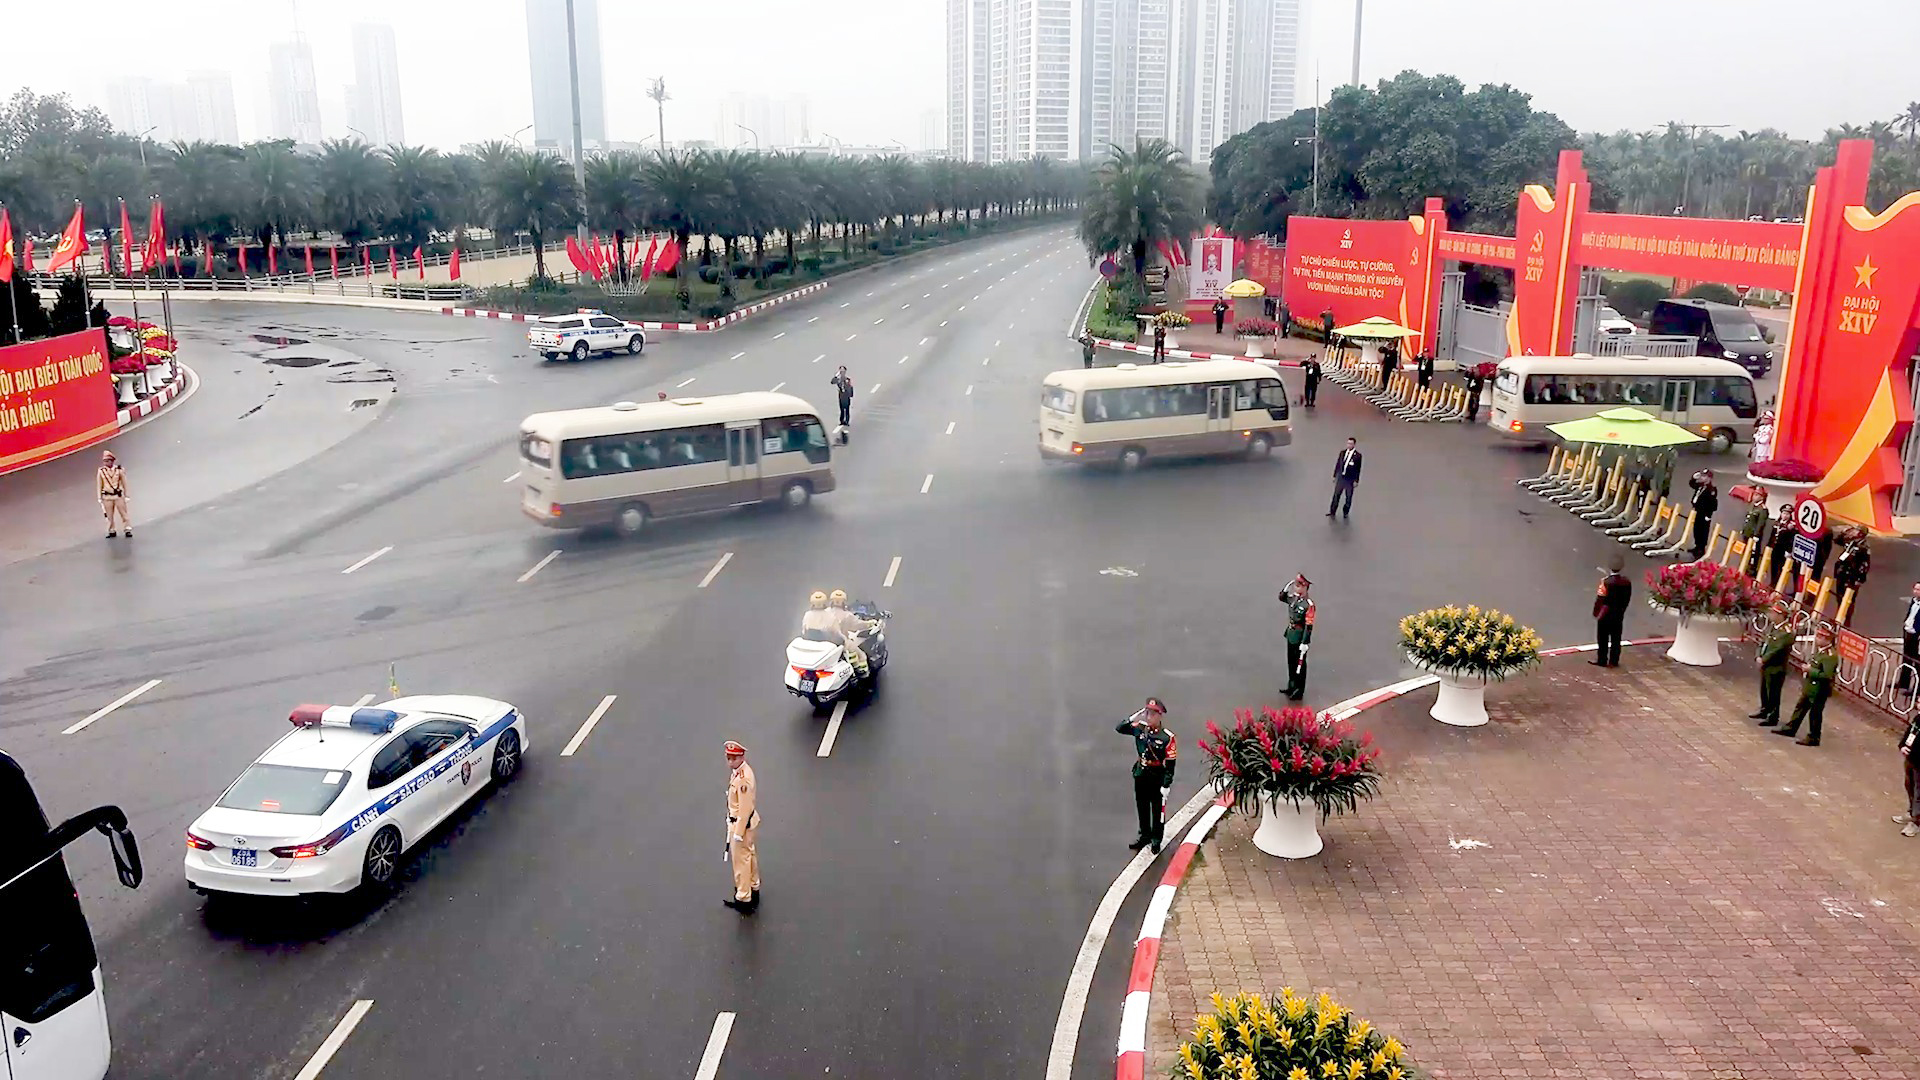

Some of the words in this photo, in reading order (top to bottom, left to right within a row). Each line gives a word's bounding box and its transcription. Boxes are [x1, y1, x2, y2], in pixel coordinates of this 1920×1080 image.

[1340, 240, 1353, 248] XIV
[1746, 247, 1759, 262] XIV
[1759, 242, 1774, 264] CỦA
[1525, 266, 1543, 282] XIV
[1843, 296, 1860, 310] ĐẠI
[1861, 296, 1880, 313] HỘI
[1839, 310, 1877, 334] XIV
[0, 369, 14, 400] ỘI
[15, 368, 36, 395] ĐẠI
[35, 356, 59, 388] BIỂU
[59, 355, 82, 382] TOÀN
[82, 346, 103, 377] QUỐC
[0, 403, 19, 432] ỦA
[20, 397, 55, 427] ĐẢNG!
[1801, 505, 1819, 530] 20
[351, 807, 380, 832] CẢNH
[400, 784, 417, 800] SÁT
